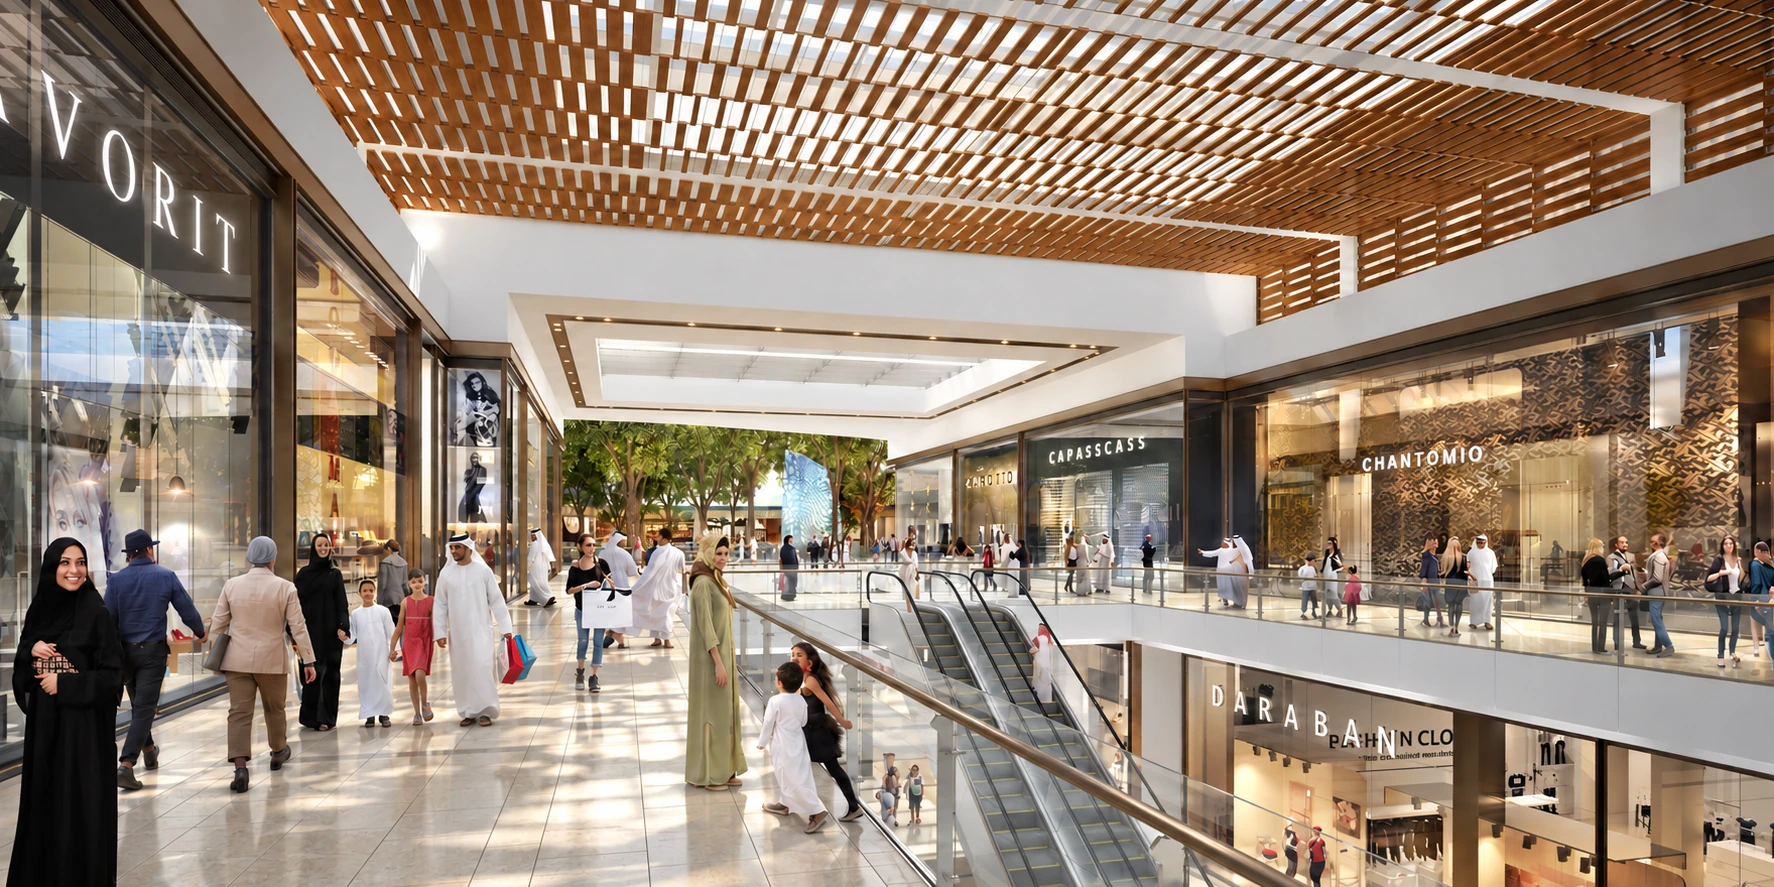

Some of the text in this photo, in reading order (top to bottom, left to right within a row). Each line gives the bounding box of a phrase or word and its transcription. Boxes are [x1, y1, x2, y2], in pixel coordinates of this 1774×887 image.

[0, 70, 236, 275] VORIT
[1048, 436, 1145, 465] CAPASSCASS
[1361, 445, 1483, 472] CHANTOMIO
[1211, 684, 1396, 759] DARABAN
